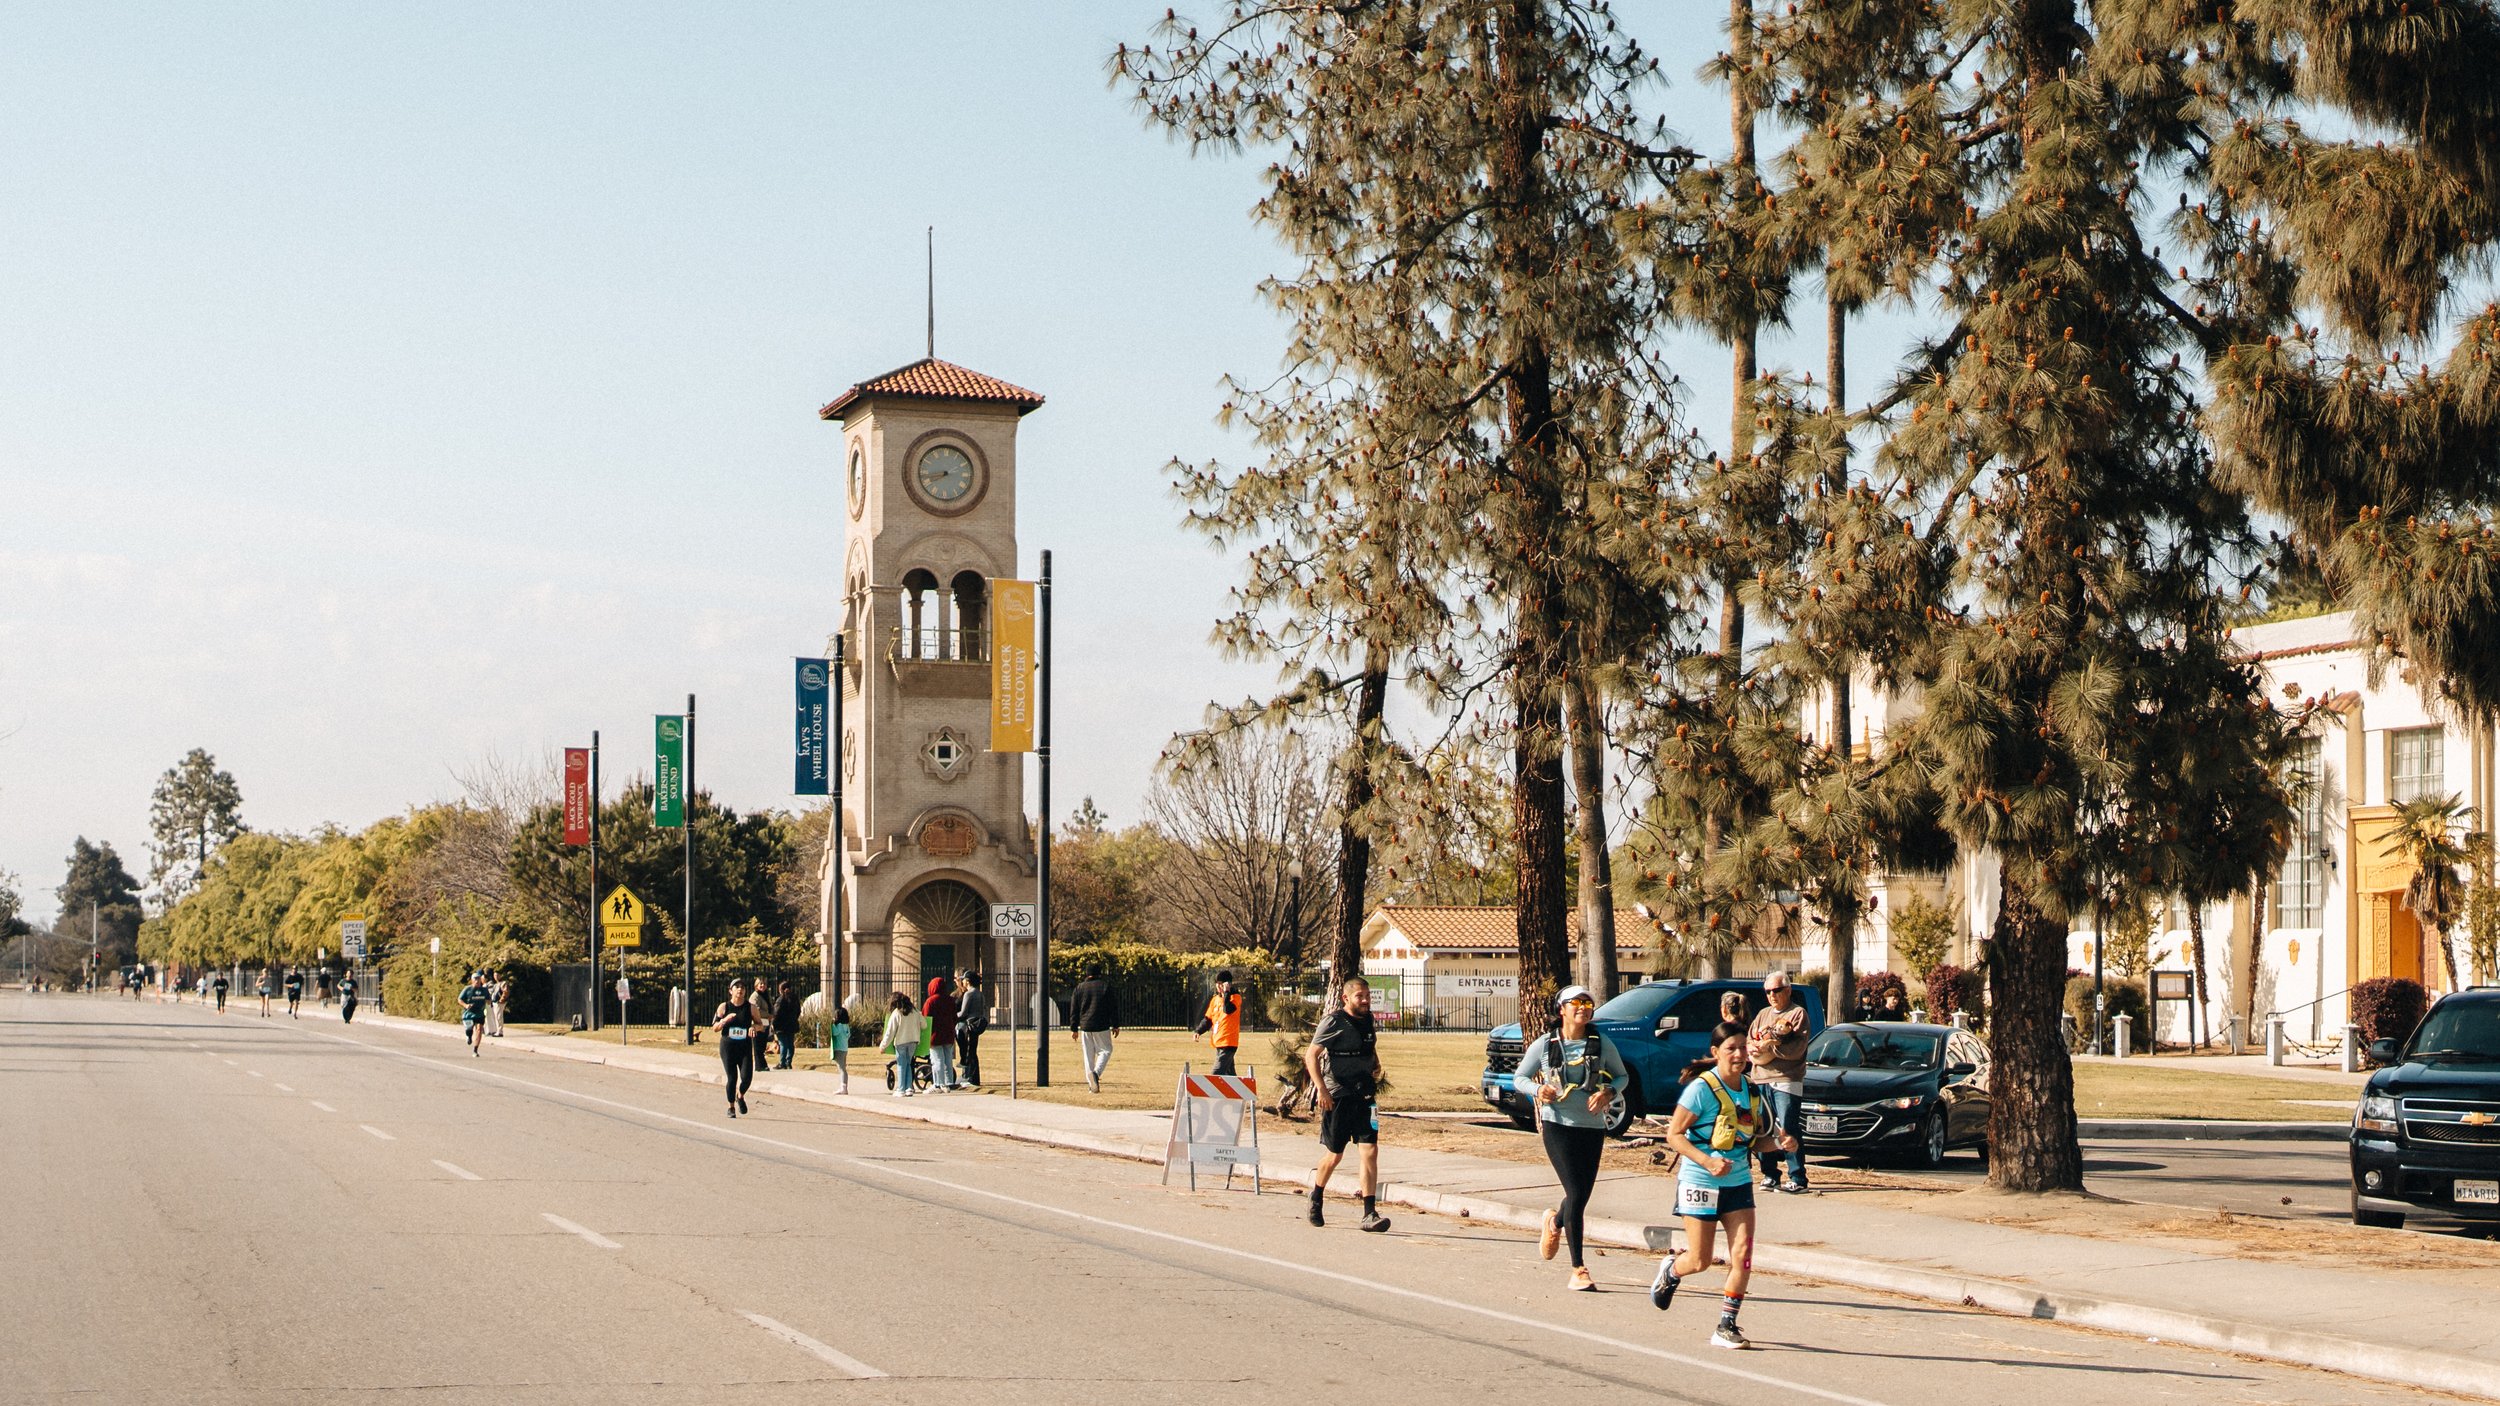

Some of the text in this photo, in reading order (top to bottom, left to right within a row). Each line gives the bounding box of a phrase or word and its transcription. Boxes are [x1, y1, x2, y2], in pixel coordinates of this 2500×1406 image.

[1001, 644, 1012, 725] LORI BROCK
[1015, 648, 1026, 723] DISCOVERY
[801, 726, 811, 756] RAY'S
[813, 703, 823, 780] WHEEL HOUSE
[660, 754, 669, 811] BAKERSFIELD
[670, 767, 678, 799] SOUND
[569, 782, 577, 831] BLACK GOLD
[345, 935, 362, 945] 25
[1458, 978, 1512, 988] ENTRANCE
[1686, 1189, 1709, 1203] 536
